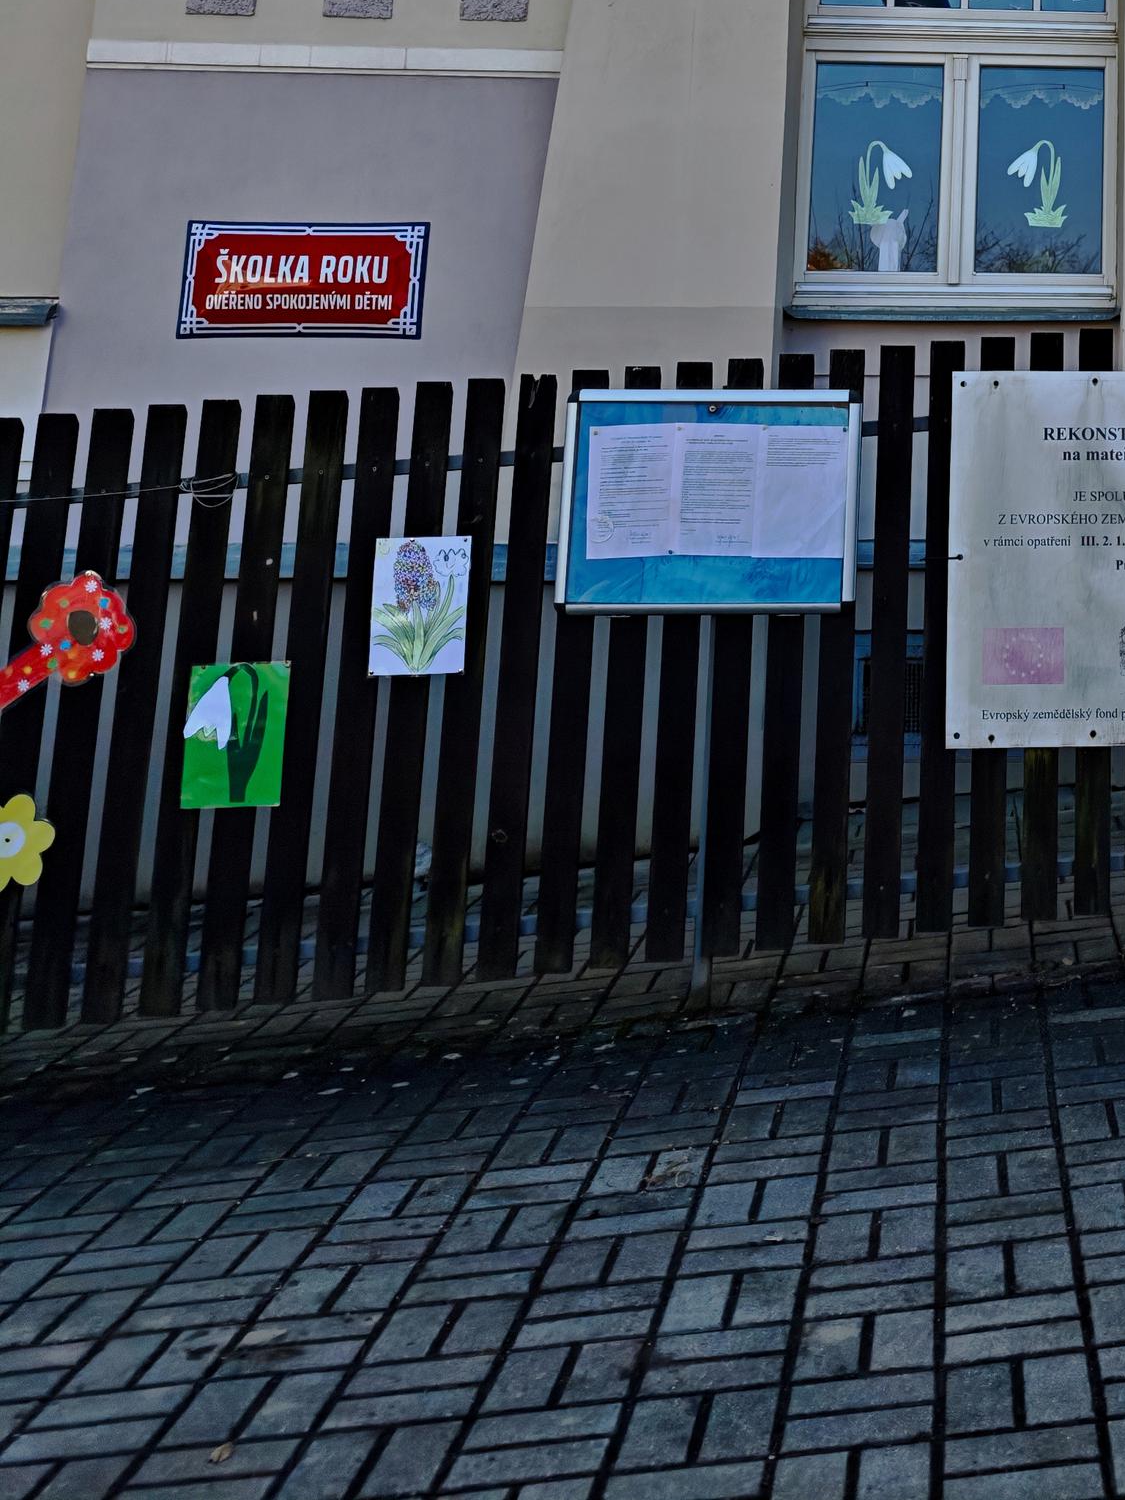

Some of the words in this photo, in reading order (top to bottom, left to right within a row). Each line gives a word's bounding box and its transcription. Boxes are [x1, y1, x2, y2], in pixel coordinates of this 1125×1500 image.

[214, 248, 310, 284] ŠKOLKA
[319, 256, 388, 284] ROKU
[205, 290, 262, 310] OVĚŘENO
[266, 290, 350, 310] SPOKOJENÝMI
[354, 292, 392, 310] DĚTMI
[1063, 451, 1081, 461] na
[1073, 491, 1087, 502] JE
[998, 514, 1007, 525] Z
[1010, 511, 1098, 525] EVROPSKÉHO
[983, 538, 990, 547] v
[993, 535, 1024, 546] rámci
[1027, 535, 1071, 549] opatření
[1081, 536, 1099, 546] III.
[1102, 536, 1112, 546] 2.
[1116, 536, 1125, 546] 1.
[982, 709, 1029, 722] Evropský
[1032, 708, 1092, 721] zemědělský
[1095, 708, 1118, 719] fond
